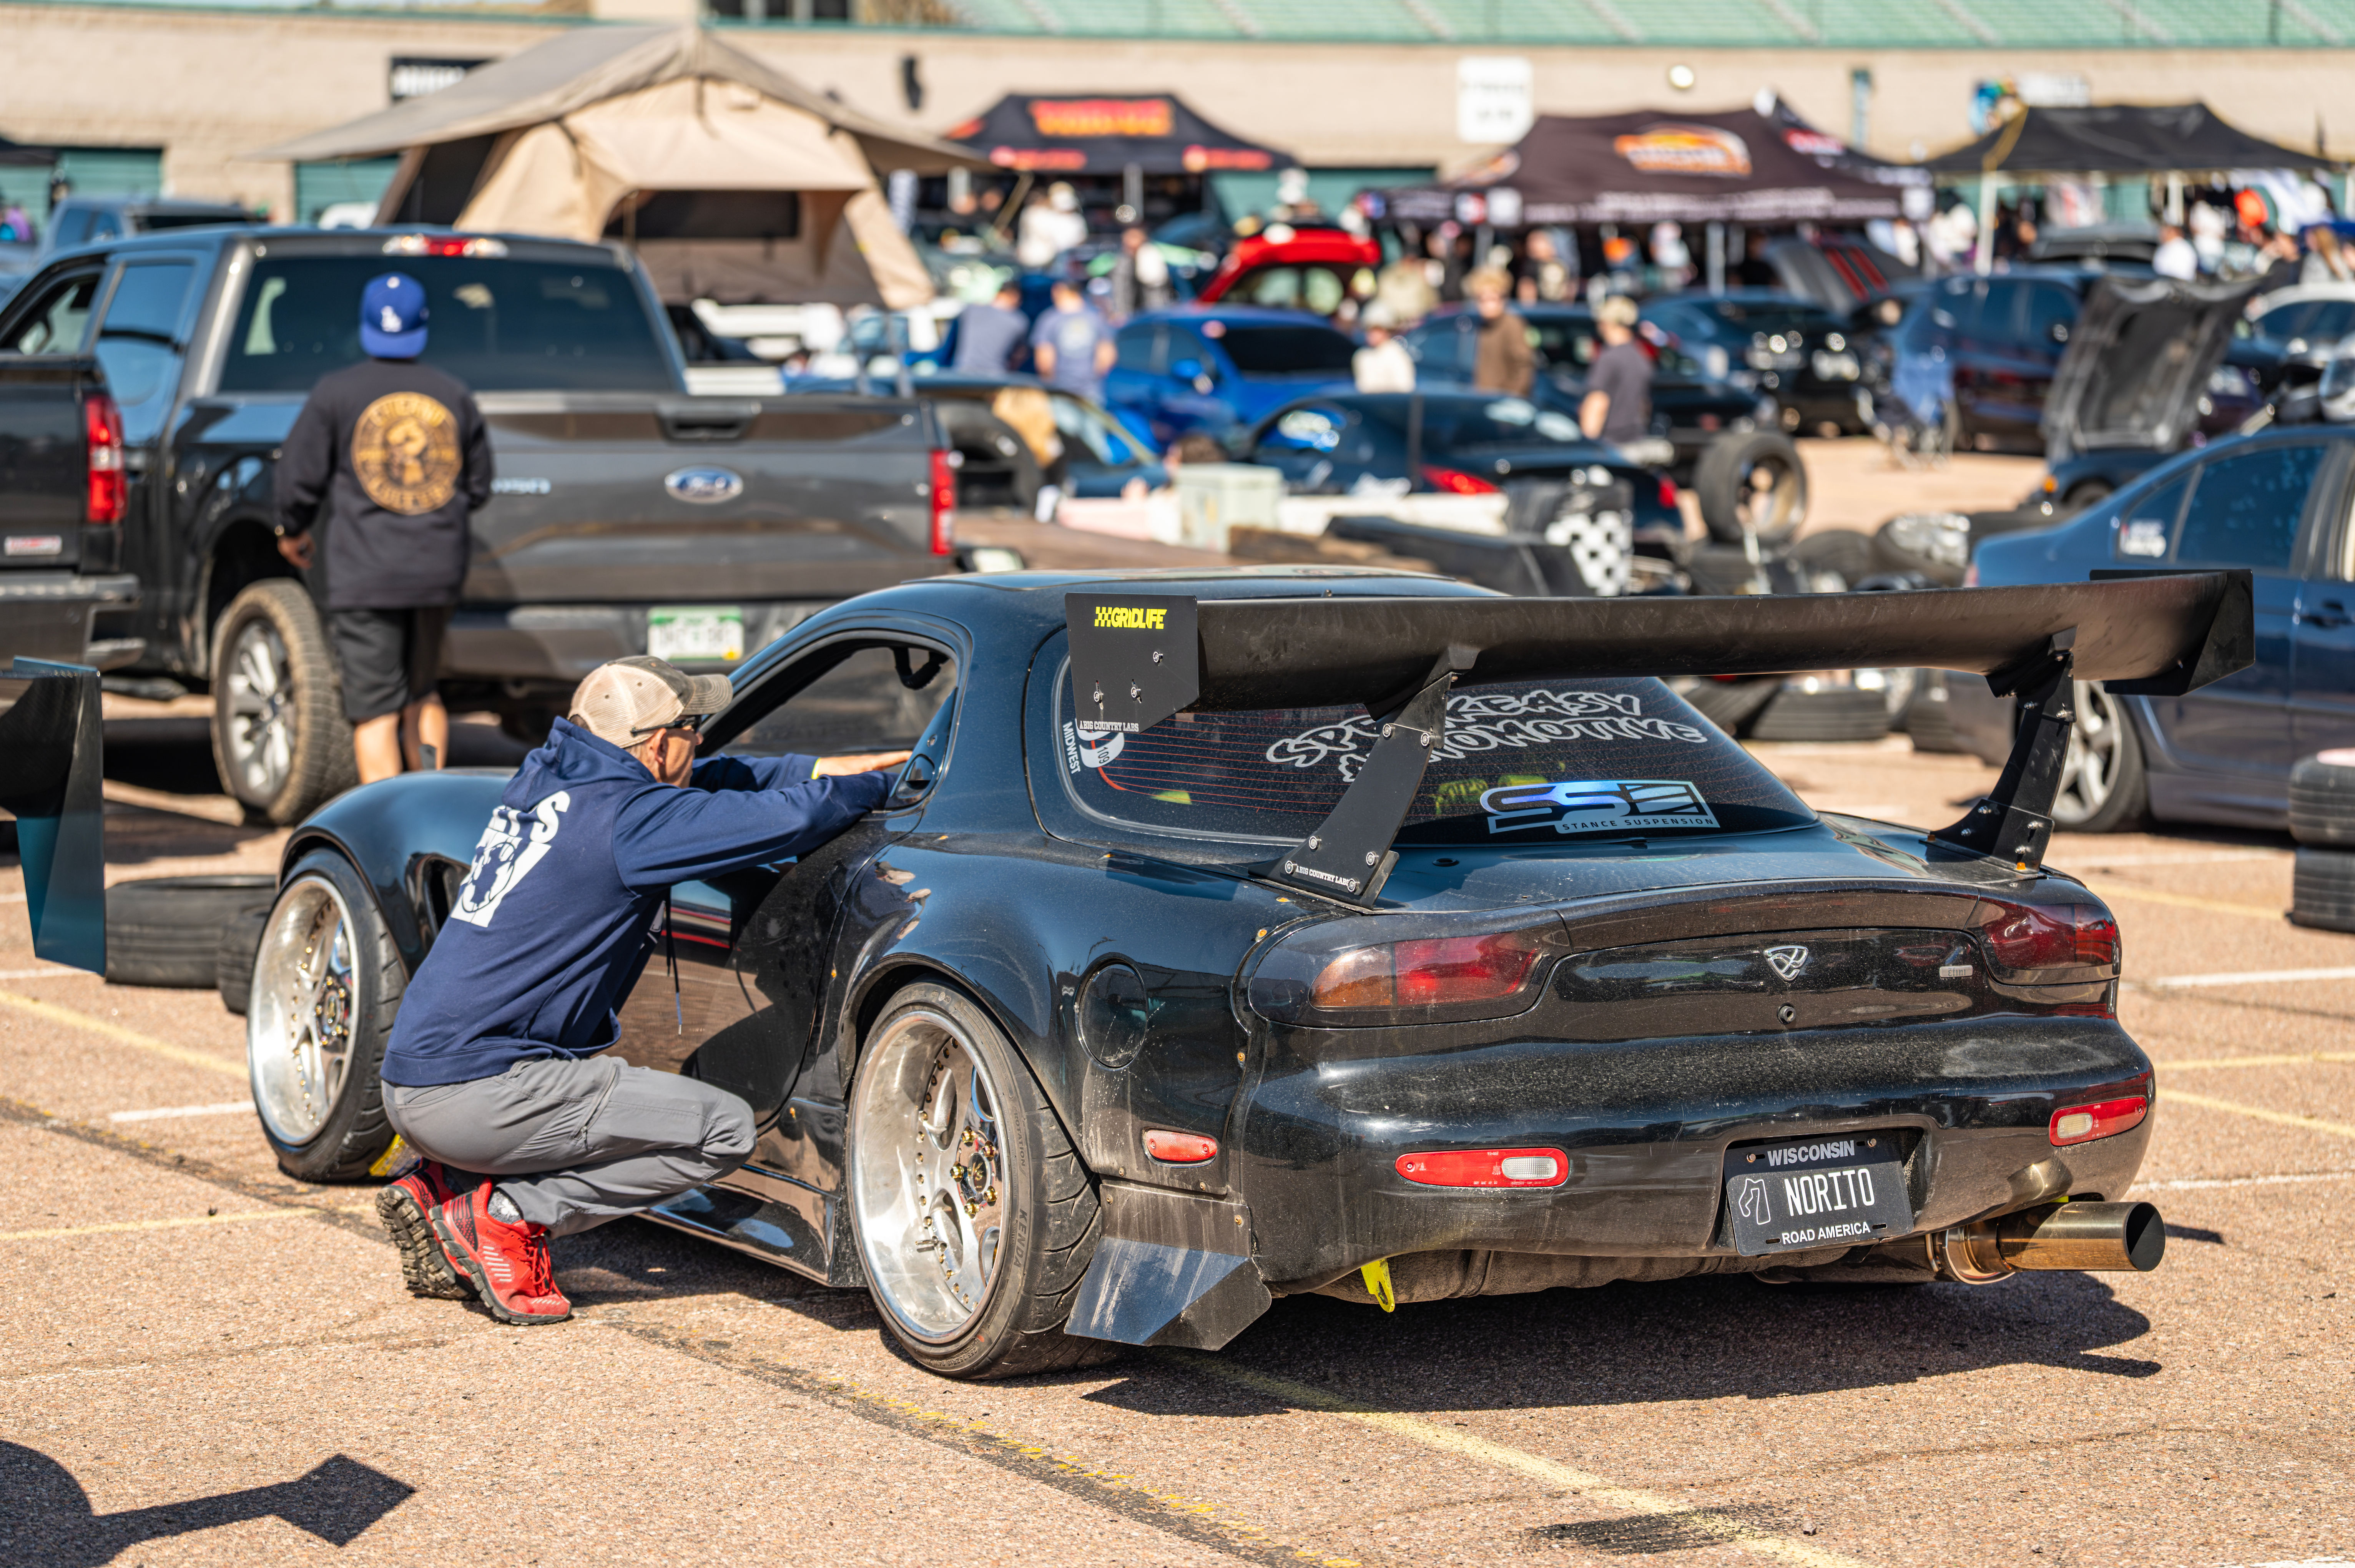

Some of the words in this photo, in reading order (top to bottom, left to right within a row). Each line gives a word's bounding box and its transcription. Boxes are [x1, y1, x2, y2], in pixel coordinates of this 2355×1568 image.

[1110, 607, 1167, 630] GRIDLIFE
[1094, 721, 1122, 731] COUNTRY
[1123, 723, 1139, 732] LABS
[1062, 721, 1081, 774] MIDWEST
[1097, 747, 1110, 764] 109
[1562, 820, 1617, 831] STANCE
[1625, 817, 1714, 826] SUSPENSION
[1309, 869, 1335, 882] COUNTRY
[1014, 1112, 1025, 1167] ROTATION
[1767, 1140, 1855, 1166] WISCONSIN
[1784, 1168, 1875, 1217] NORITO
[1014, 1208, 1027, 1268] KENDA
[1782, 1229, 1815, 1245] ROAD
[1818, 1221, 1871, 1240] AMERICA
